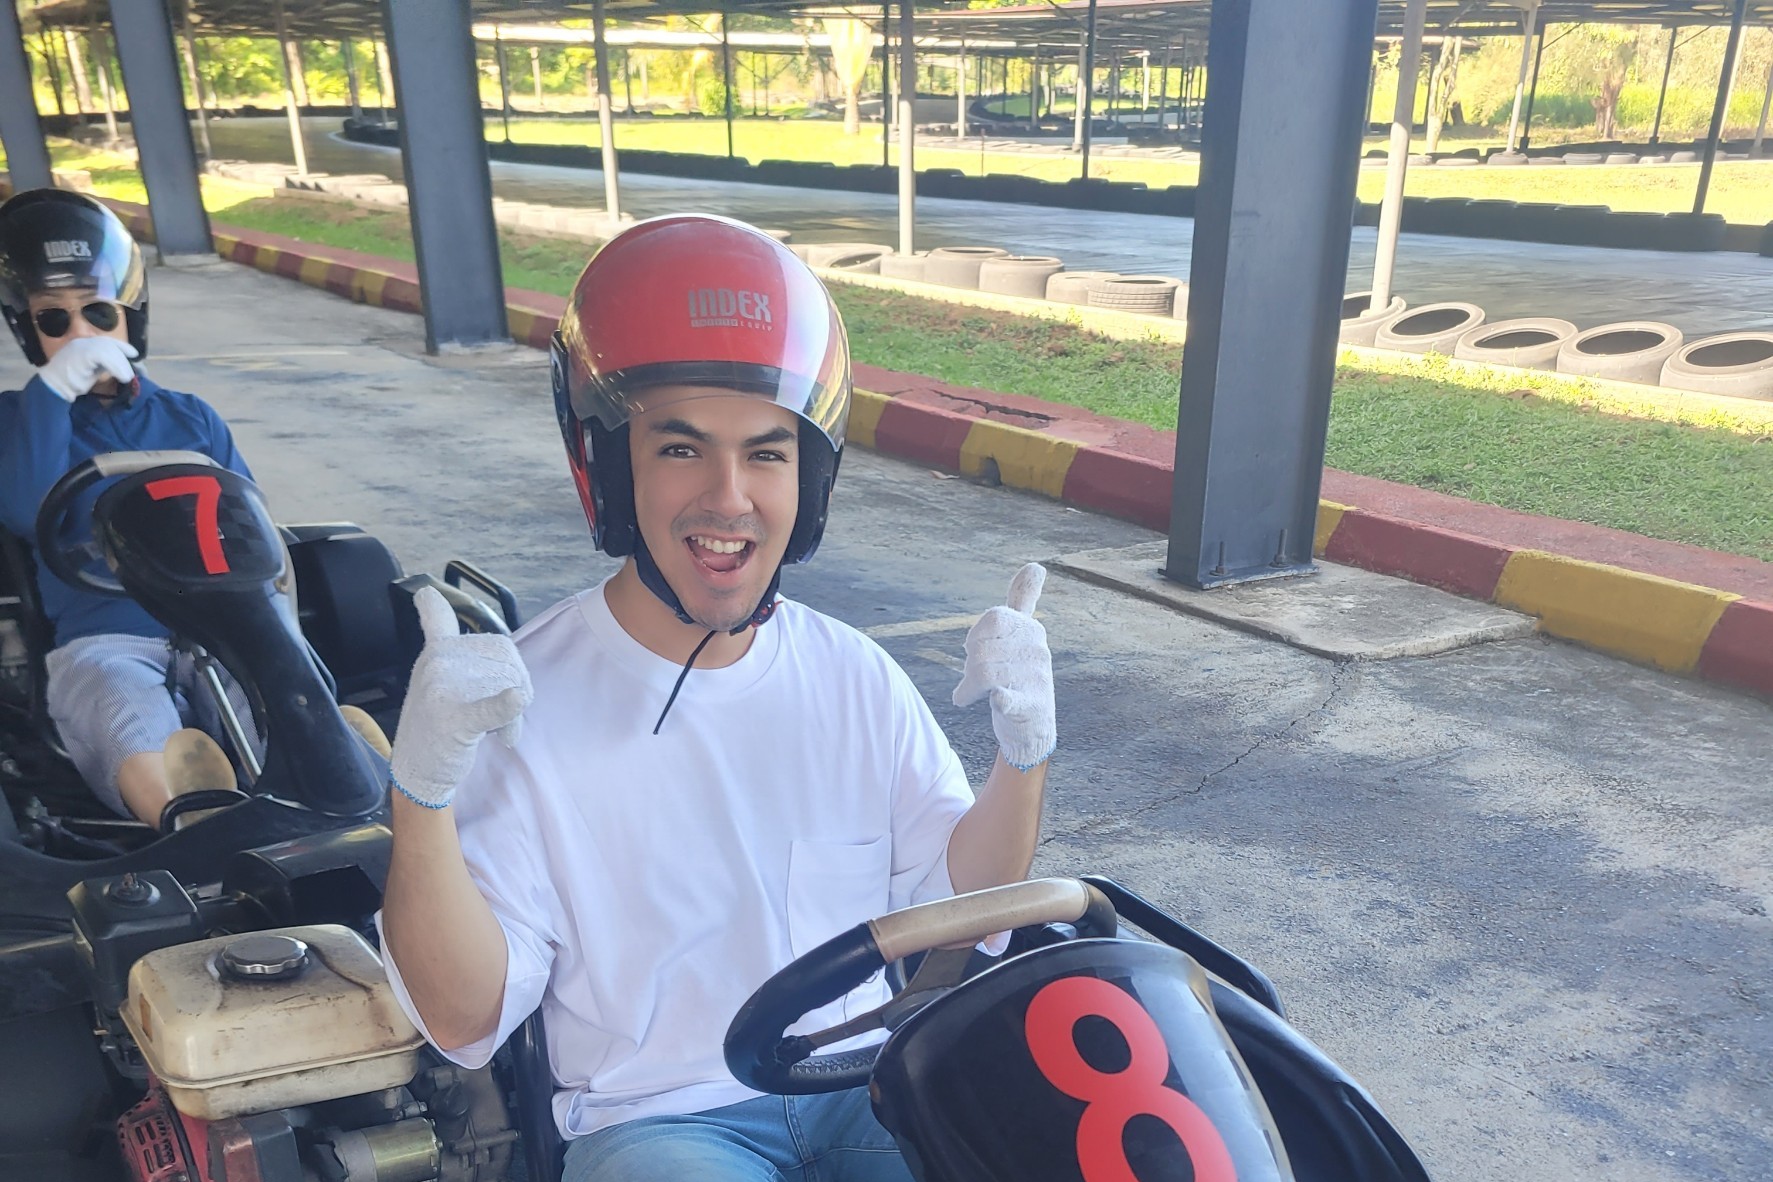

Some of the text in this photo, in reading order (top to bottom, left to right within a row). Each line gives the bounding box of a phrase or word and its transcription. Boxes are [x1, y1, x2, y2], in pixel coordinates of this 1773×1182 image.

[43, 240, 92, 258] INDEX
[687, 287, 772, 323] INDEX
[144, 475, 231, 575] 7
